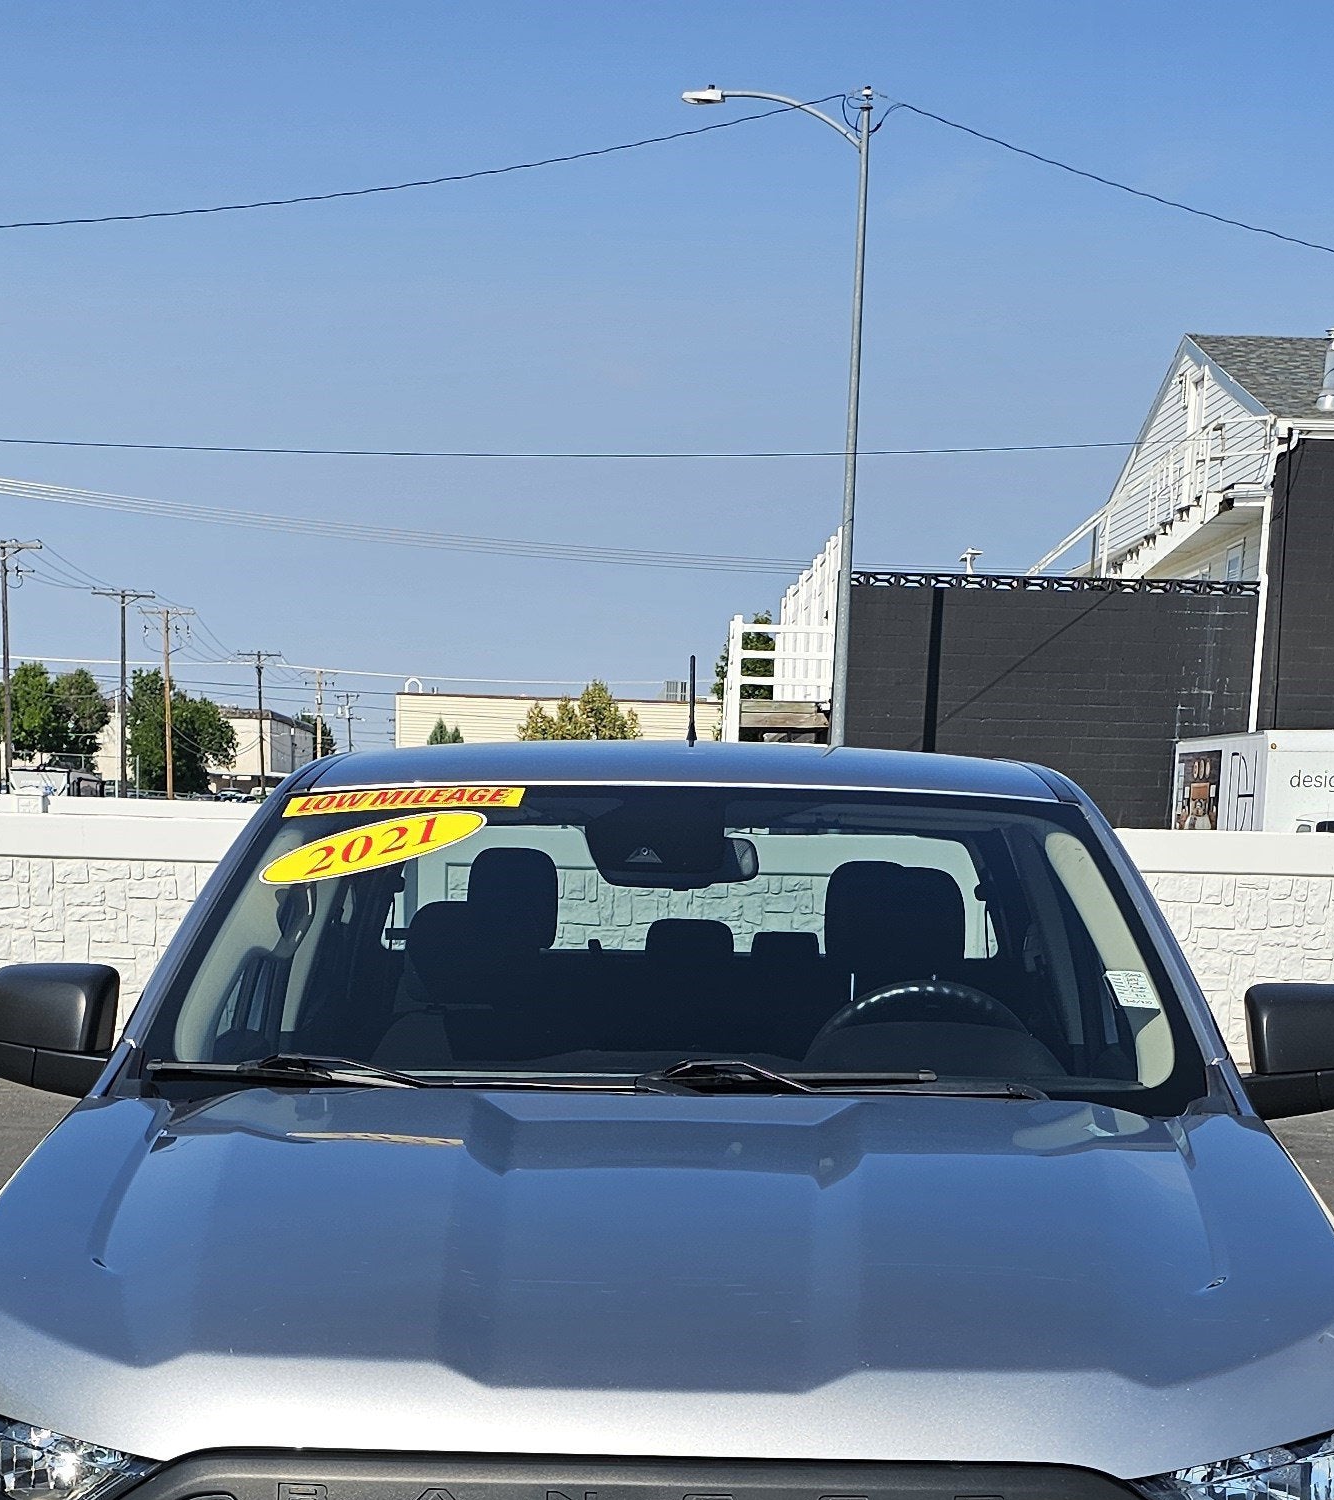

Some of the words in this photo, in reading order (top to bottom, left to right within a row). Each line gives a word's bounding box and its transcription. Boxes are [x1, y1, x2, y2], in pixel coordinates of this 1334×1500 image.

[295, 792, 365, 812] LOW
[369, 787, 509, 807] MILEAGE
[303, 816, 439, 877] 2021
